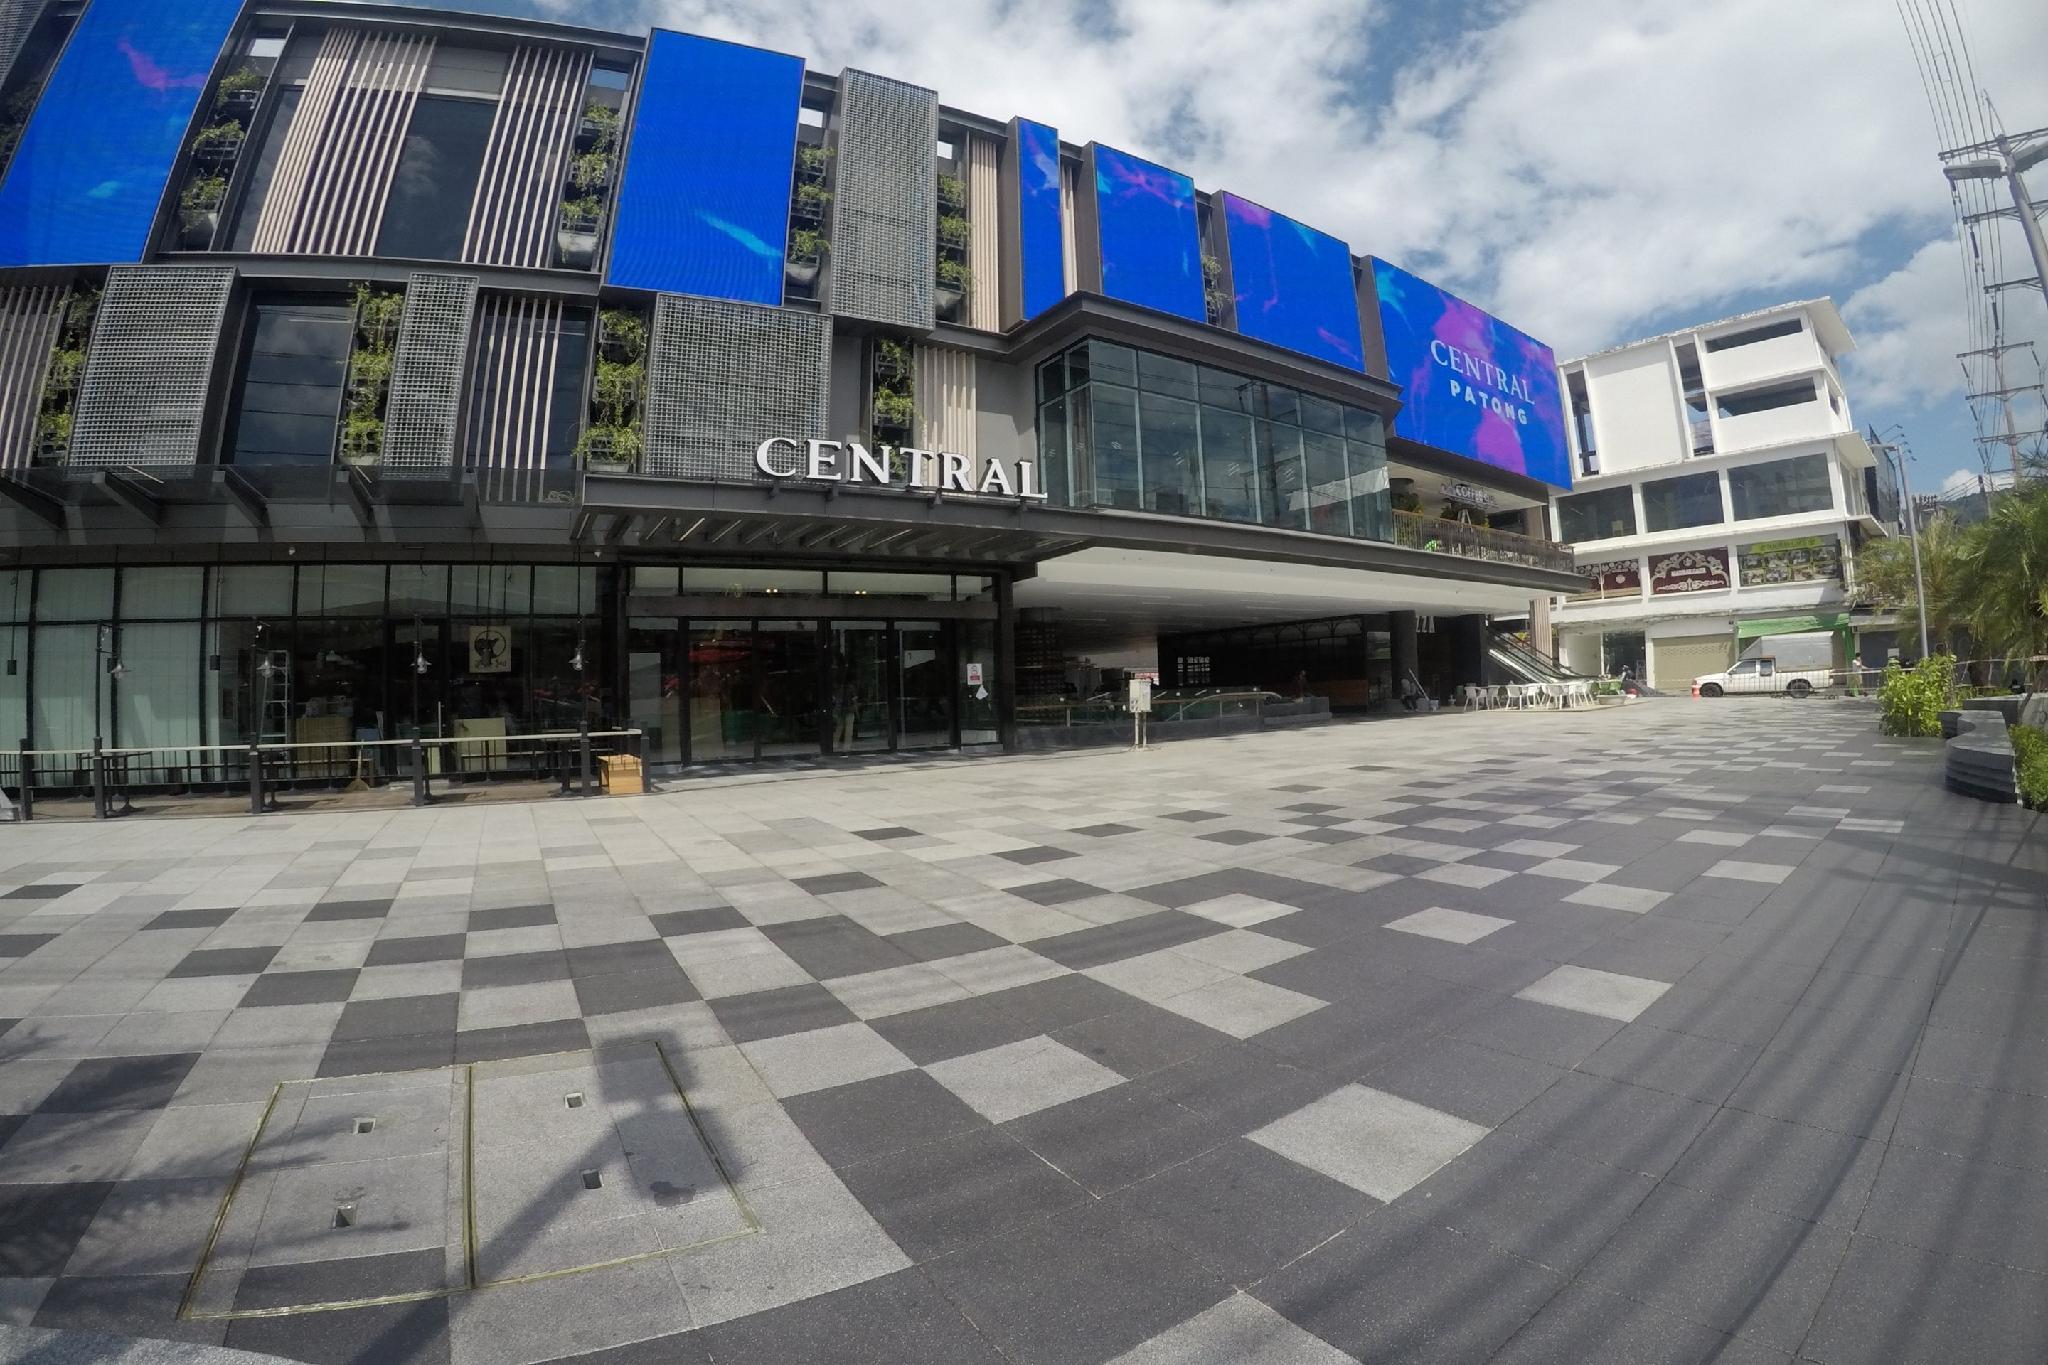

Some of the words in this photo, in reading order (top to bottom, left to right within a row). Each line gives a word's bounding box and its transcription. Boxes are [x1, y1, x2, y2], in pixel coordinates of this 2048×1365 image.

[1431, 340, 1535, 405] CENTRAL
[1450, 380, 1528, 424] PATONG
[757, 437, 1048, 499] CENTRAL
